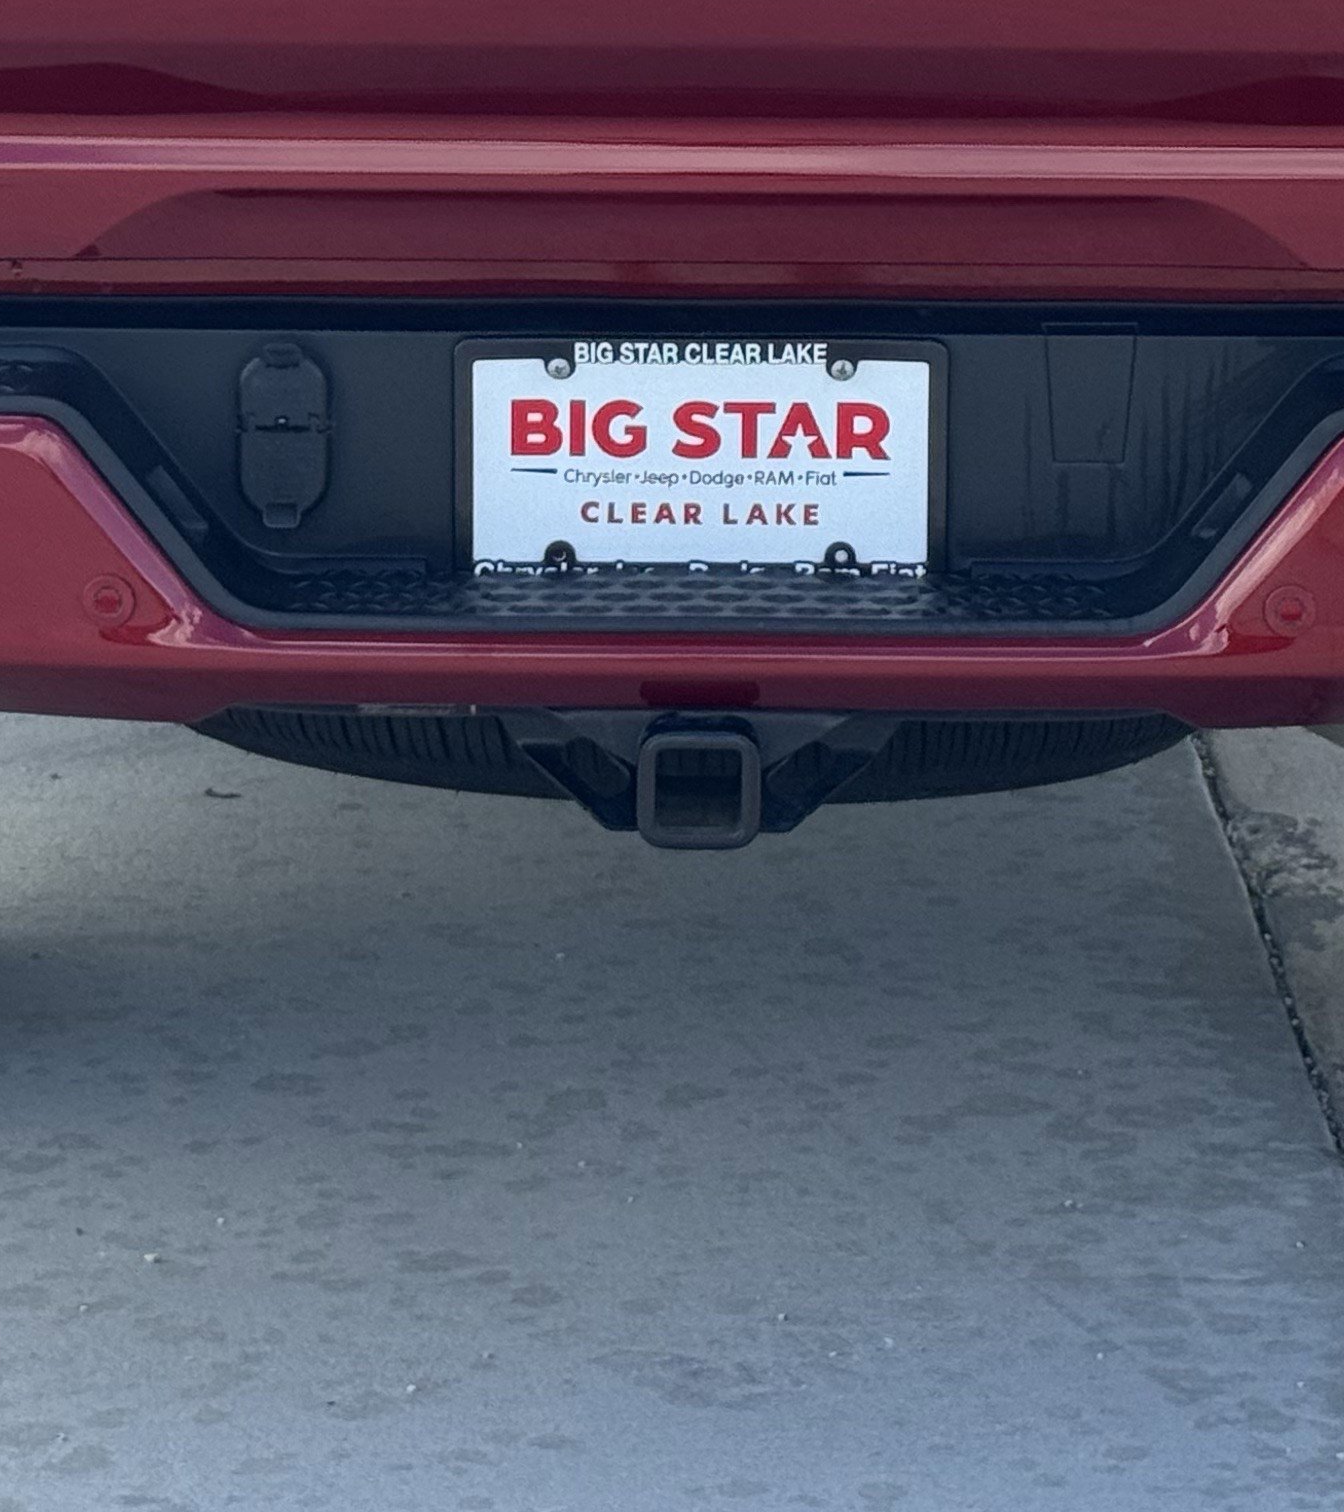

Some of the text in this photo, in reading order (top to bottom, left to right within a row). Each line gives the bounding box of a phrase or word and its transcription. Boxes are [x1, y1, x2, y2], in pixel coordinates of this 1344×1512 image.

[574, 341, 828, 365] BIG STAR CLEAR LAKE
[510, 399, 891, 461] BIG STAR
[563, 469, 838, 488] Chrysler Jeep Dodge RAM Fiat
[581, 500, 820, 526] CLEAR LAKE
